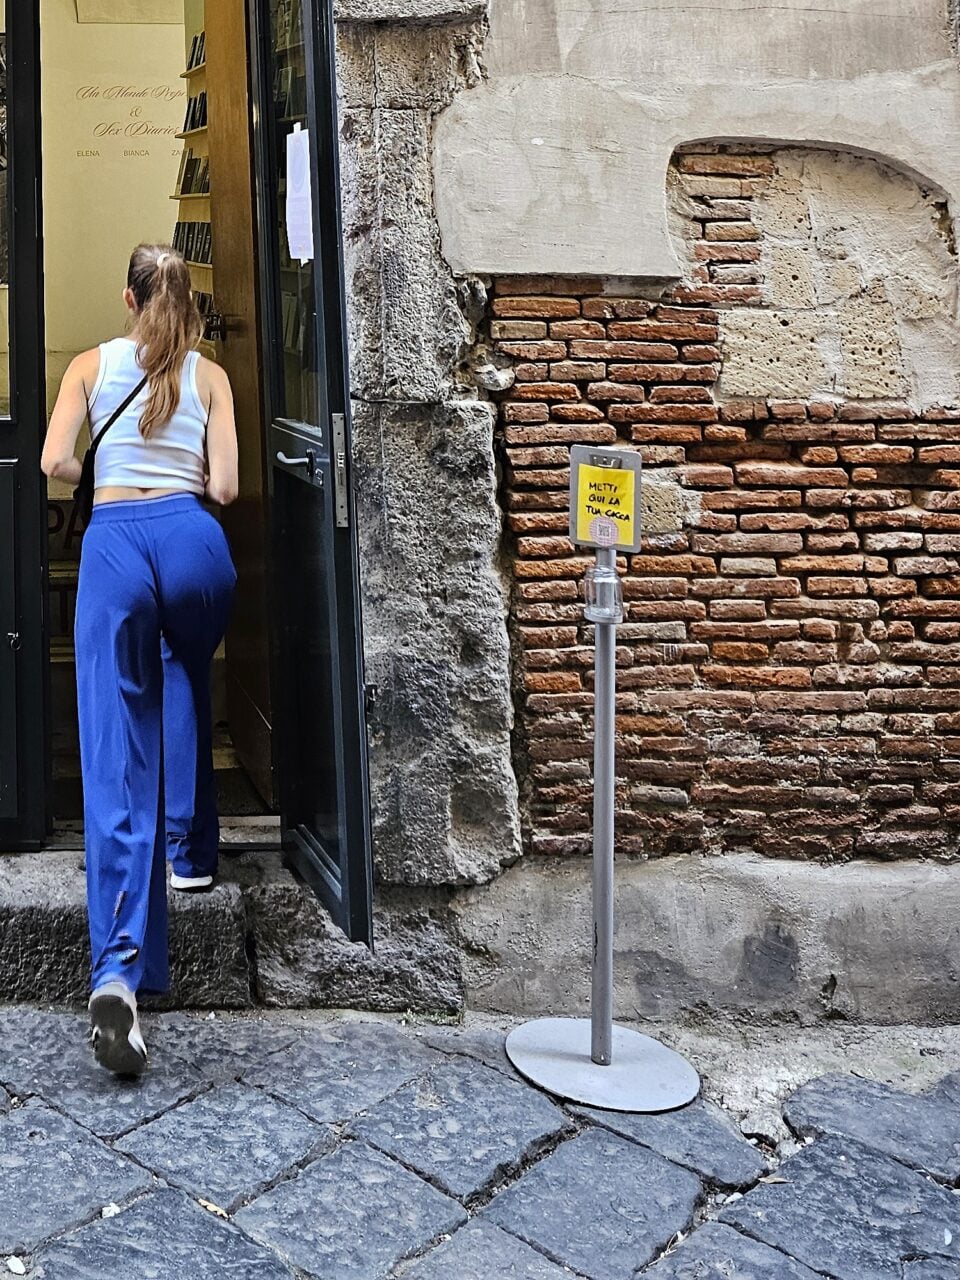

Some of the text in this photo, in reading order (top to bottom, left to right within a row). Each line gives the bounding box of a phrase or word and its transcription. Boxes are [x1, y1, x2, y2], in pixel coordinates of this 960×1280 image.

[93, 121, 122, 137] Sex
[123, 149, 150, 157] BIANCA
[171, 149, 181, 157] ZA
[588, 482, 618, 493] METTI
[588, 494, 620, 506] QUI LA
[585, 505, 602, 516] TUA
